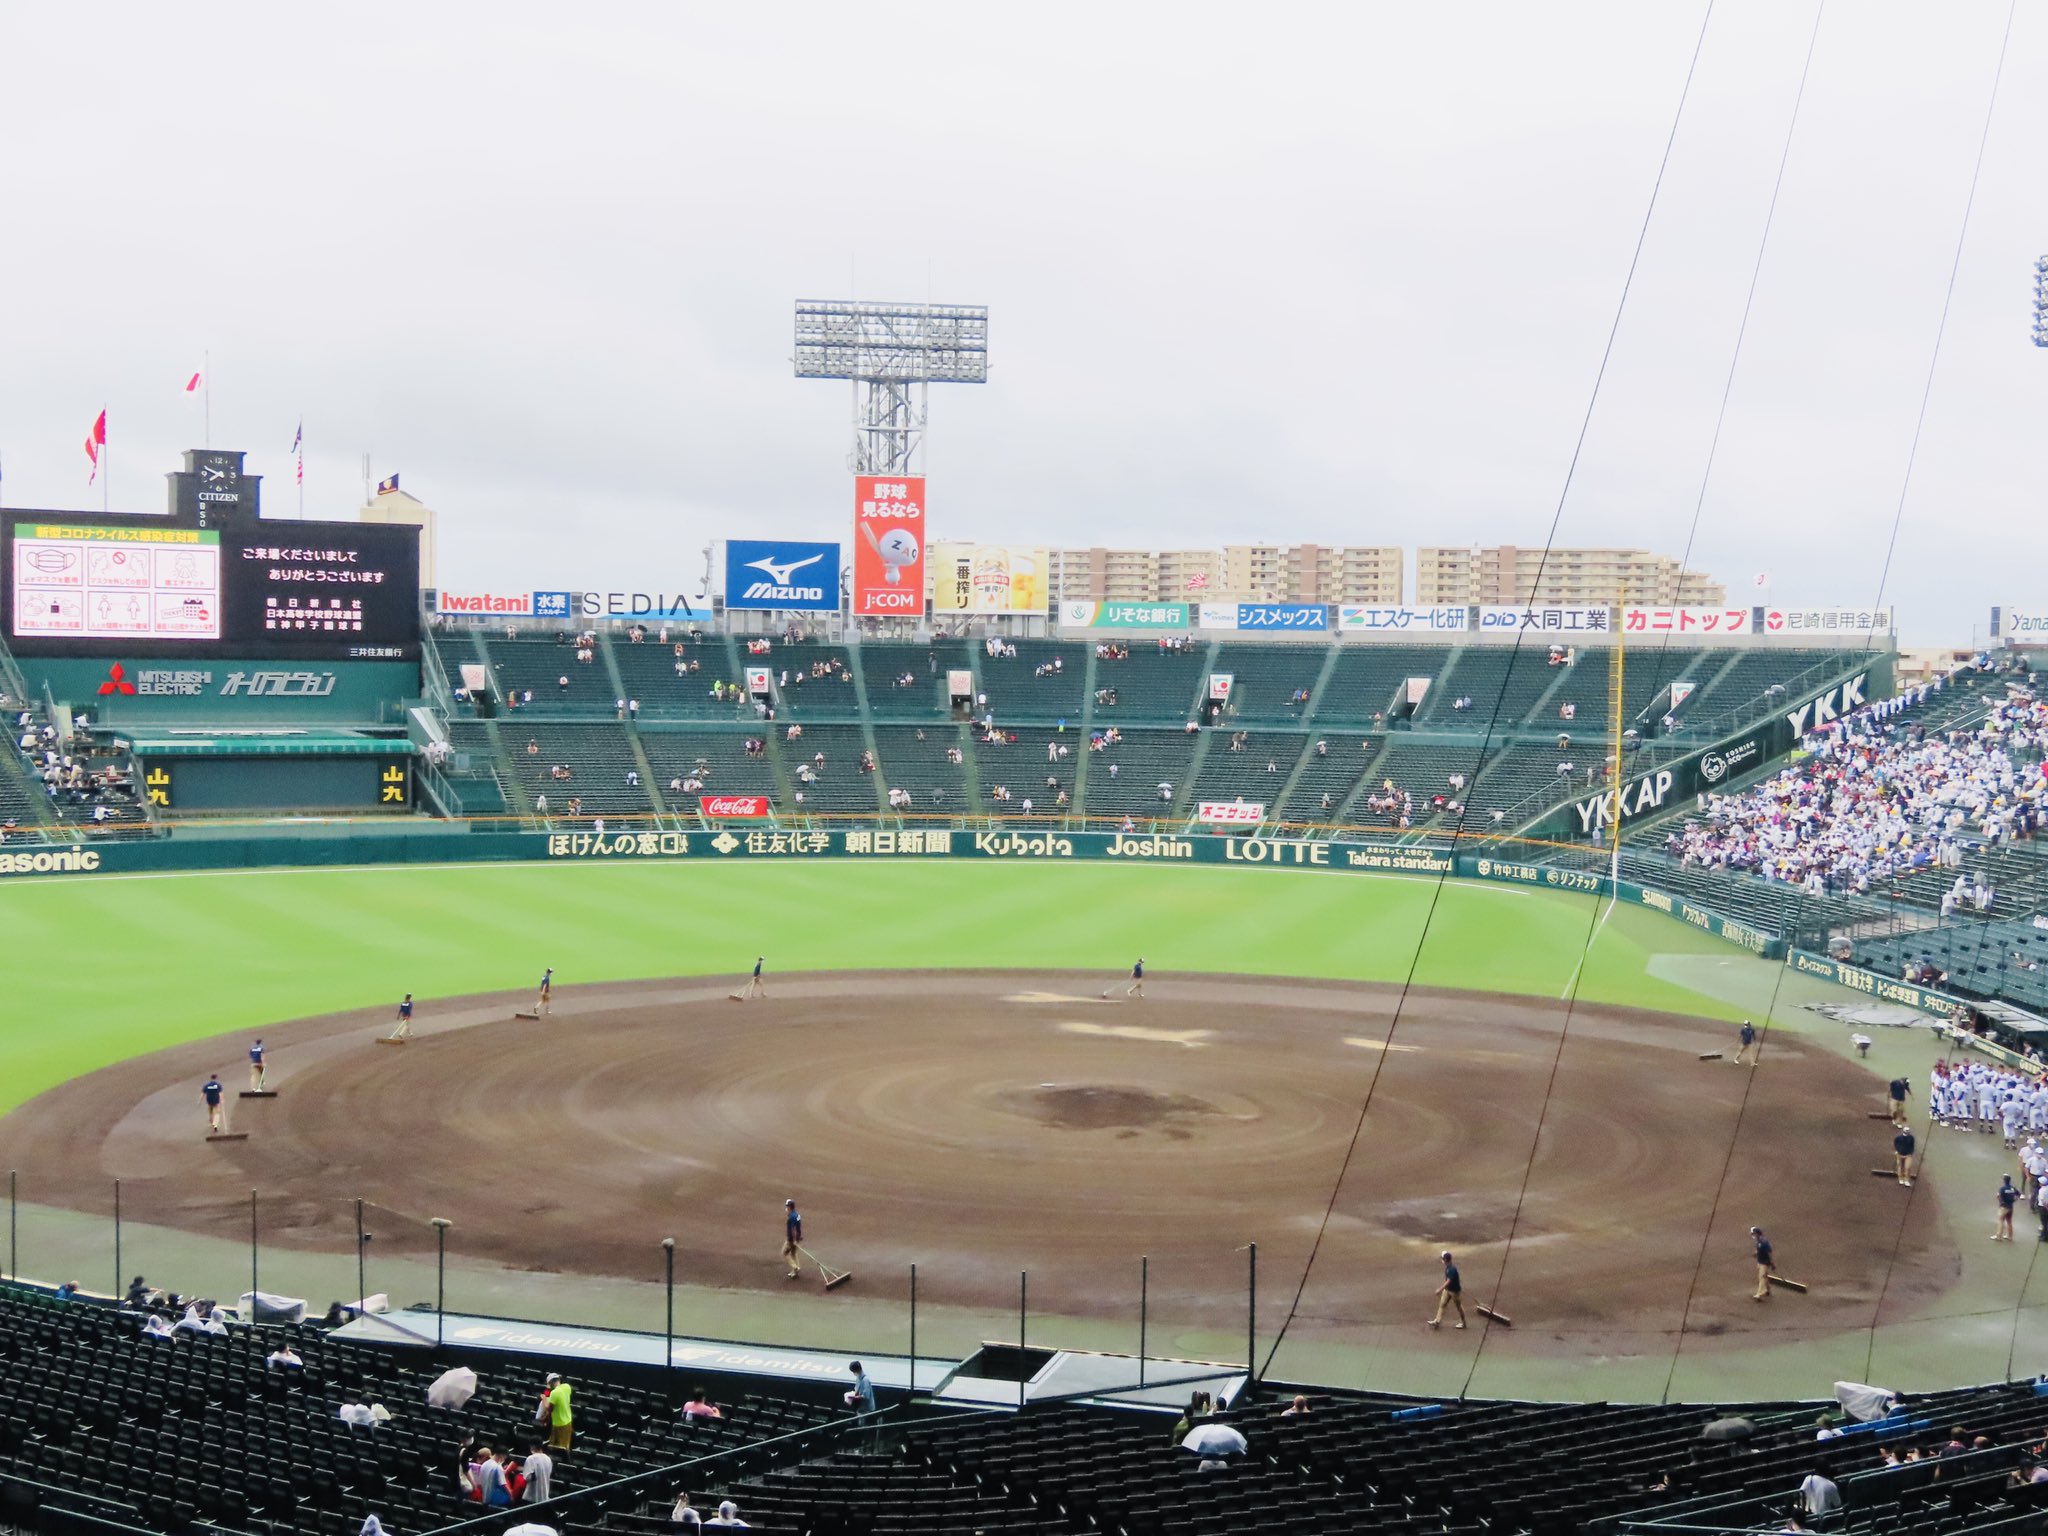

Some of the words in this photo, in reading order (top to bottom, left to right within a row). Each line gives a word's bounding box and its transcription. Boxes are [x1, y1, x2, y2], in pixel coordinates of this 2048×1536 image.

[198, 492, 239, 502] CITIZEN
[874, 483, 907, 499] 野球
[862, 501, 920, 518] 見るなら
[243, 548, 358, 563] ご来場くださいまして
[269, 568, 385, 584] ありがとうございます
[956, 558, 970, 609] 一番搾り
[442, 592, 528, 612] Iwatani
[537, 594, 566, 608] 水素
[583, 592, 693, 617] SEDIA
[864, 593, 914, 609] J:COM
[1109, 607, 1181, 624] りそな銀行
[1239, 607, 1324, 626] シスメックス
[1365, 608, 1464, 629] エスケー化研
[1520, 609, 1607, 631] 大同工業
[1626, 609, 1748, 632] カニトップ
[1787, 611, 1888, 630] 尼崎信用金庫
[350, 648, 402, 657] 三井住友銀行
[138, 671, 211, 683] MITSUBISHI
[138, 683, 202, 695] ELECTRIC
[1786, 672, 1867, 741] YKK
[147, 767, 169, 806] 山九
[383, 765, 404, 802] 山九
[1634, 770, 1672, 814] AP
[708, 798, 758, 815] Coca-Cola
[548, 832, 681, 856] ほけんの窓口
[744, 832, 829, 853] 住友化学
[845, 832, 951, 854] 朝日新聞
[975, 832, 1072, 856] Kubota
[1106, 835, 1192, 858] Joshin
[1226, 840, 1329, 864] LOTTE
[0, 845, 99, 873] asonic
[1346, 851, 1390, 867] Takara
[1392, 855, 1452, 871] standard
[1493, 863, 1537, 880] 竹中工務店
[498, 1329, 622, 1353] idemitsu
[715, 1350, 844, 1375] idemitsu
